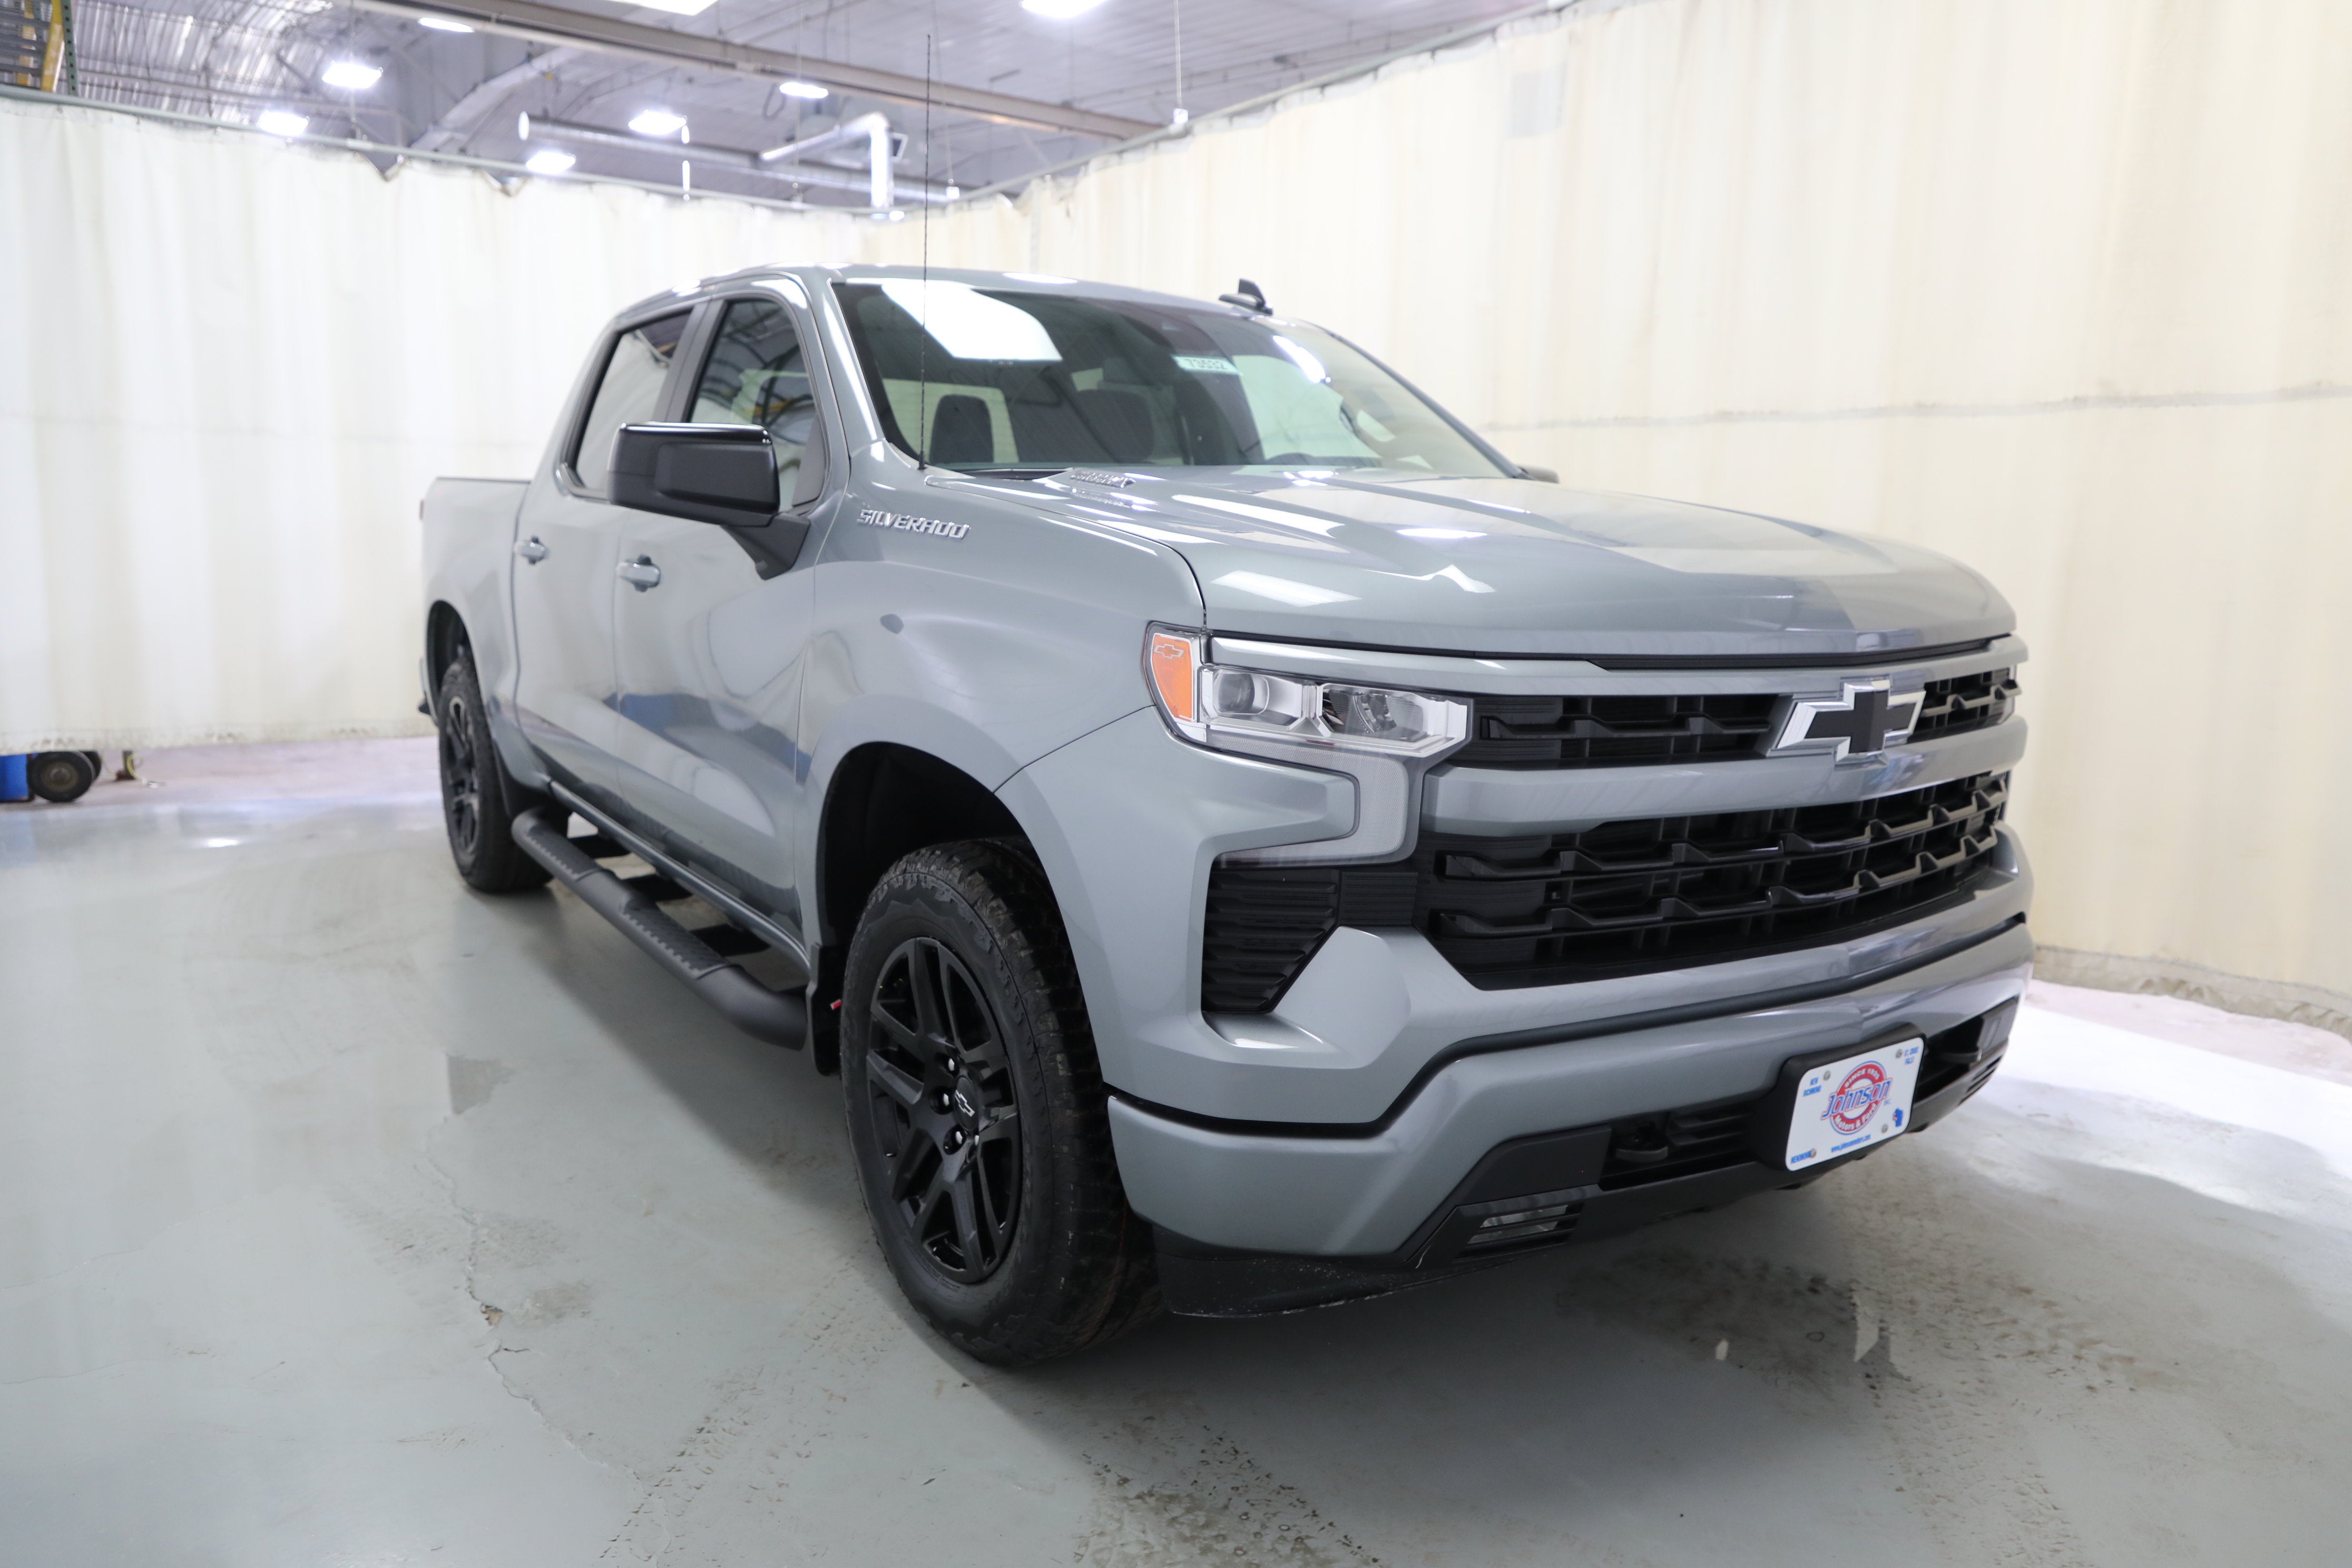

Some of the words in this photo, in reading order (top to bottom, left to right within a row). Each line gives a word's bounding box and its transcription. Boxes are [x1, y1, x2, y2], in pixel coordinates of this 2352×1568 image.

[857, 509, 971, 540] SILVERADO
[1845, 1067, 1867, 1088] SINCE
[1821, 1079, 1892, 1118] Johnson
[1834, 1114, 1855, 1131] Motors
[1855, 1118, 1863, 1128] &
